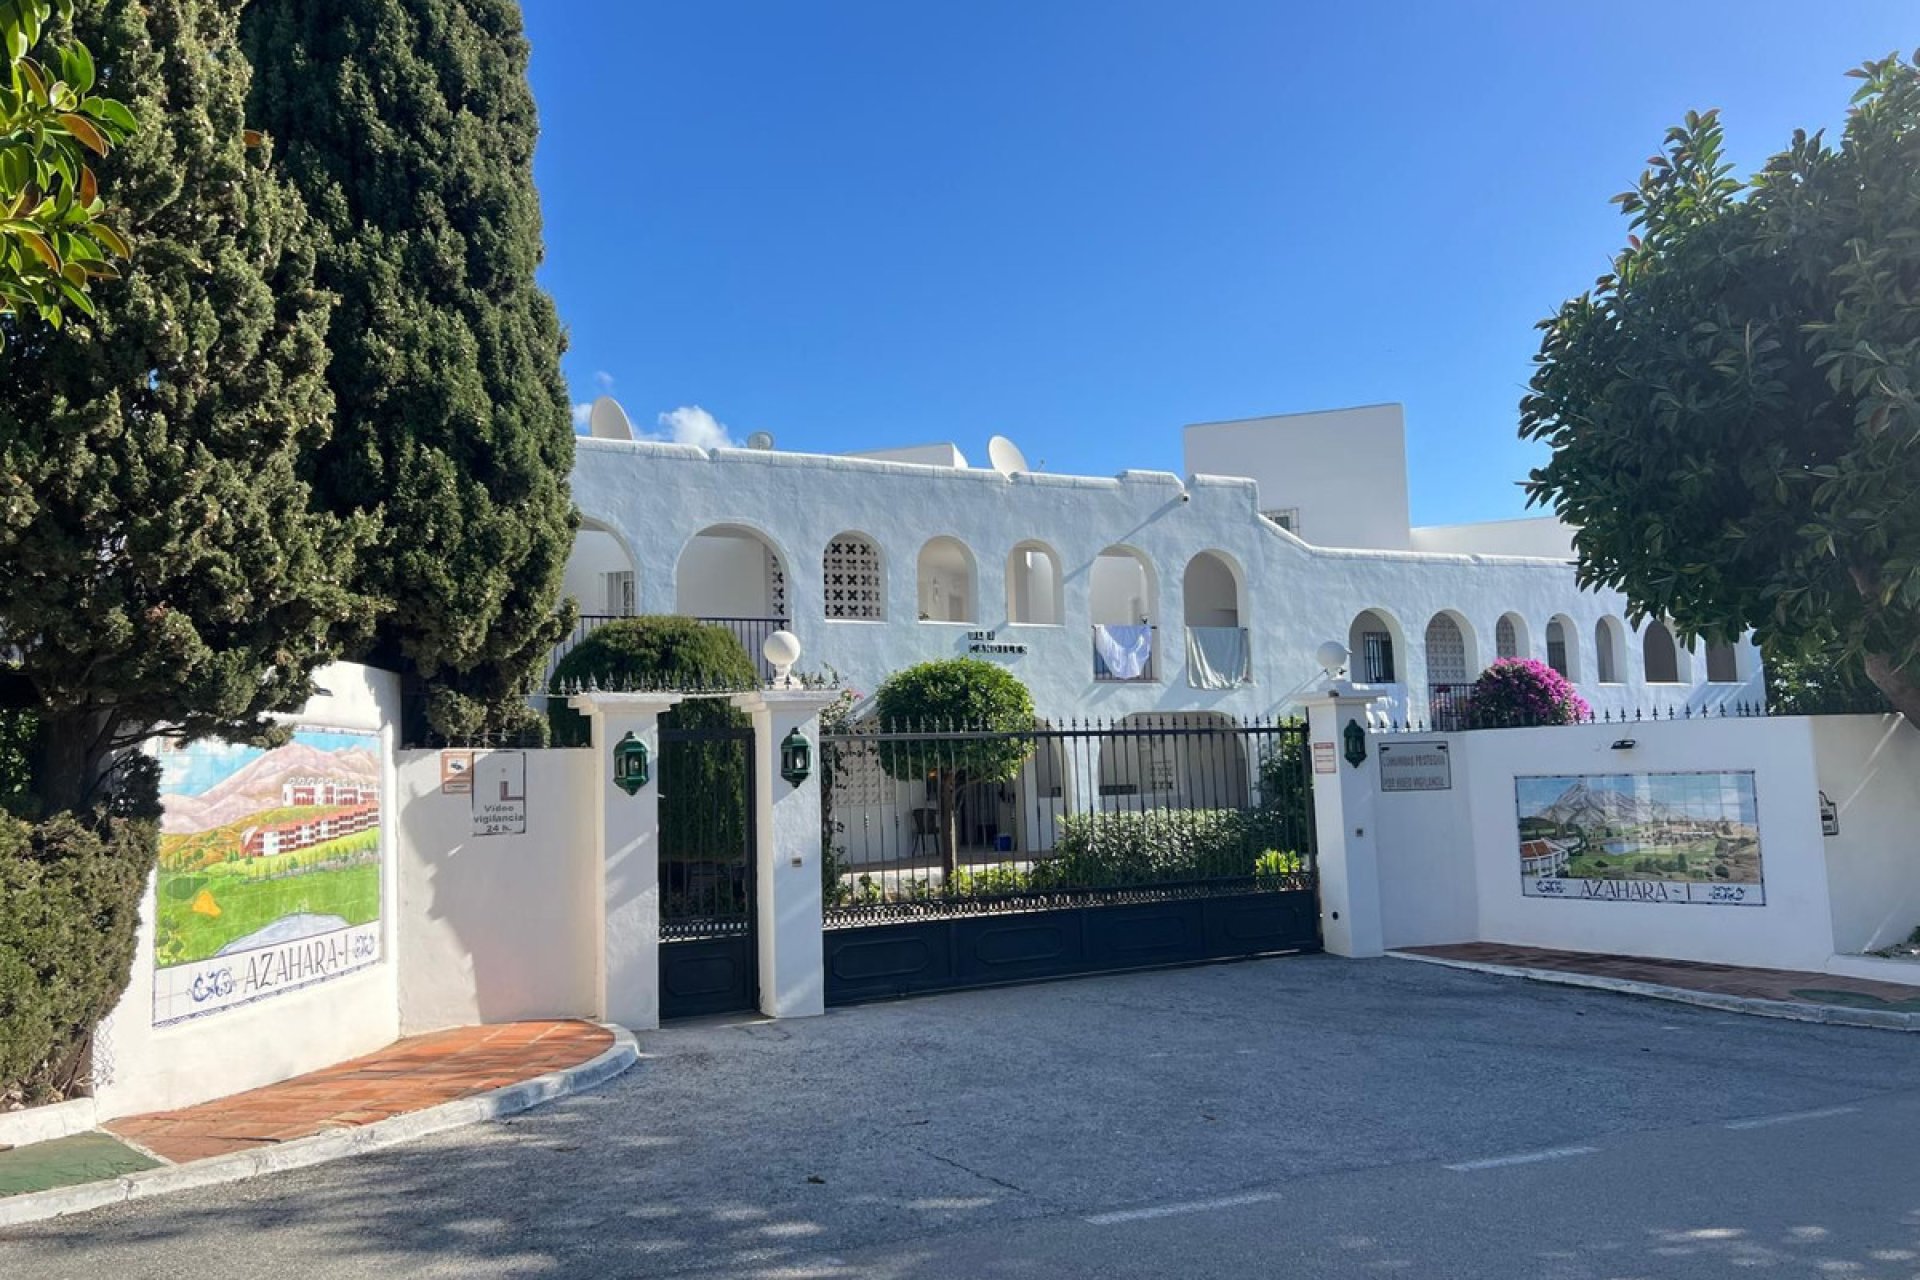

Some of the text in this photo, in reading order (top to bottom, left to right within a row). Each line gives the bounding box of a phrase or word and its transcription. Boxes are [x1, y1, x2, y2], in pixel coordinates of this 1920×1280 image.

[484, 804, 514, 812] Video
[473, 813, 525, 824] vigilancia
[486, 824, 499, 833] 24
[1580, 879, 1668, 900] AZAHARA
